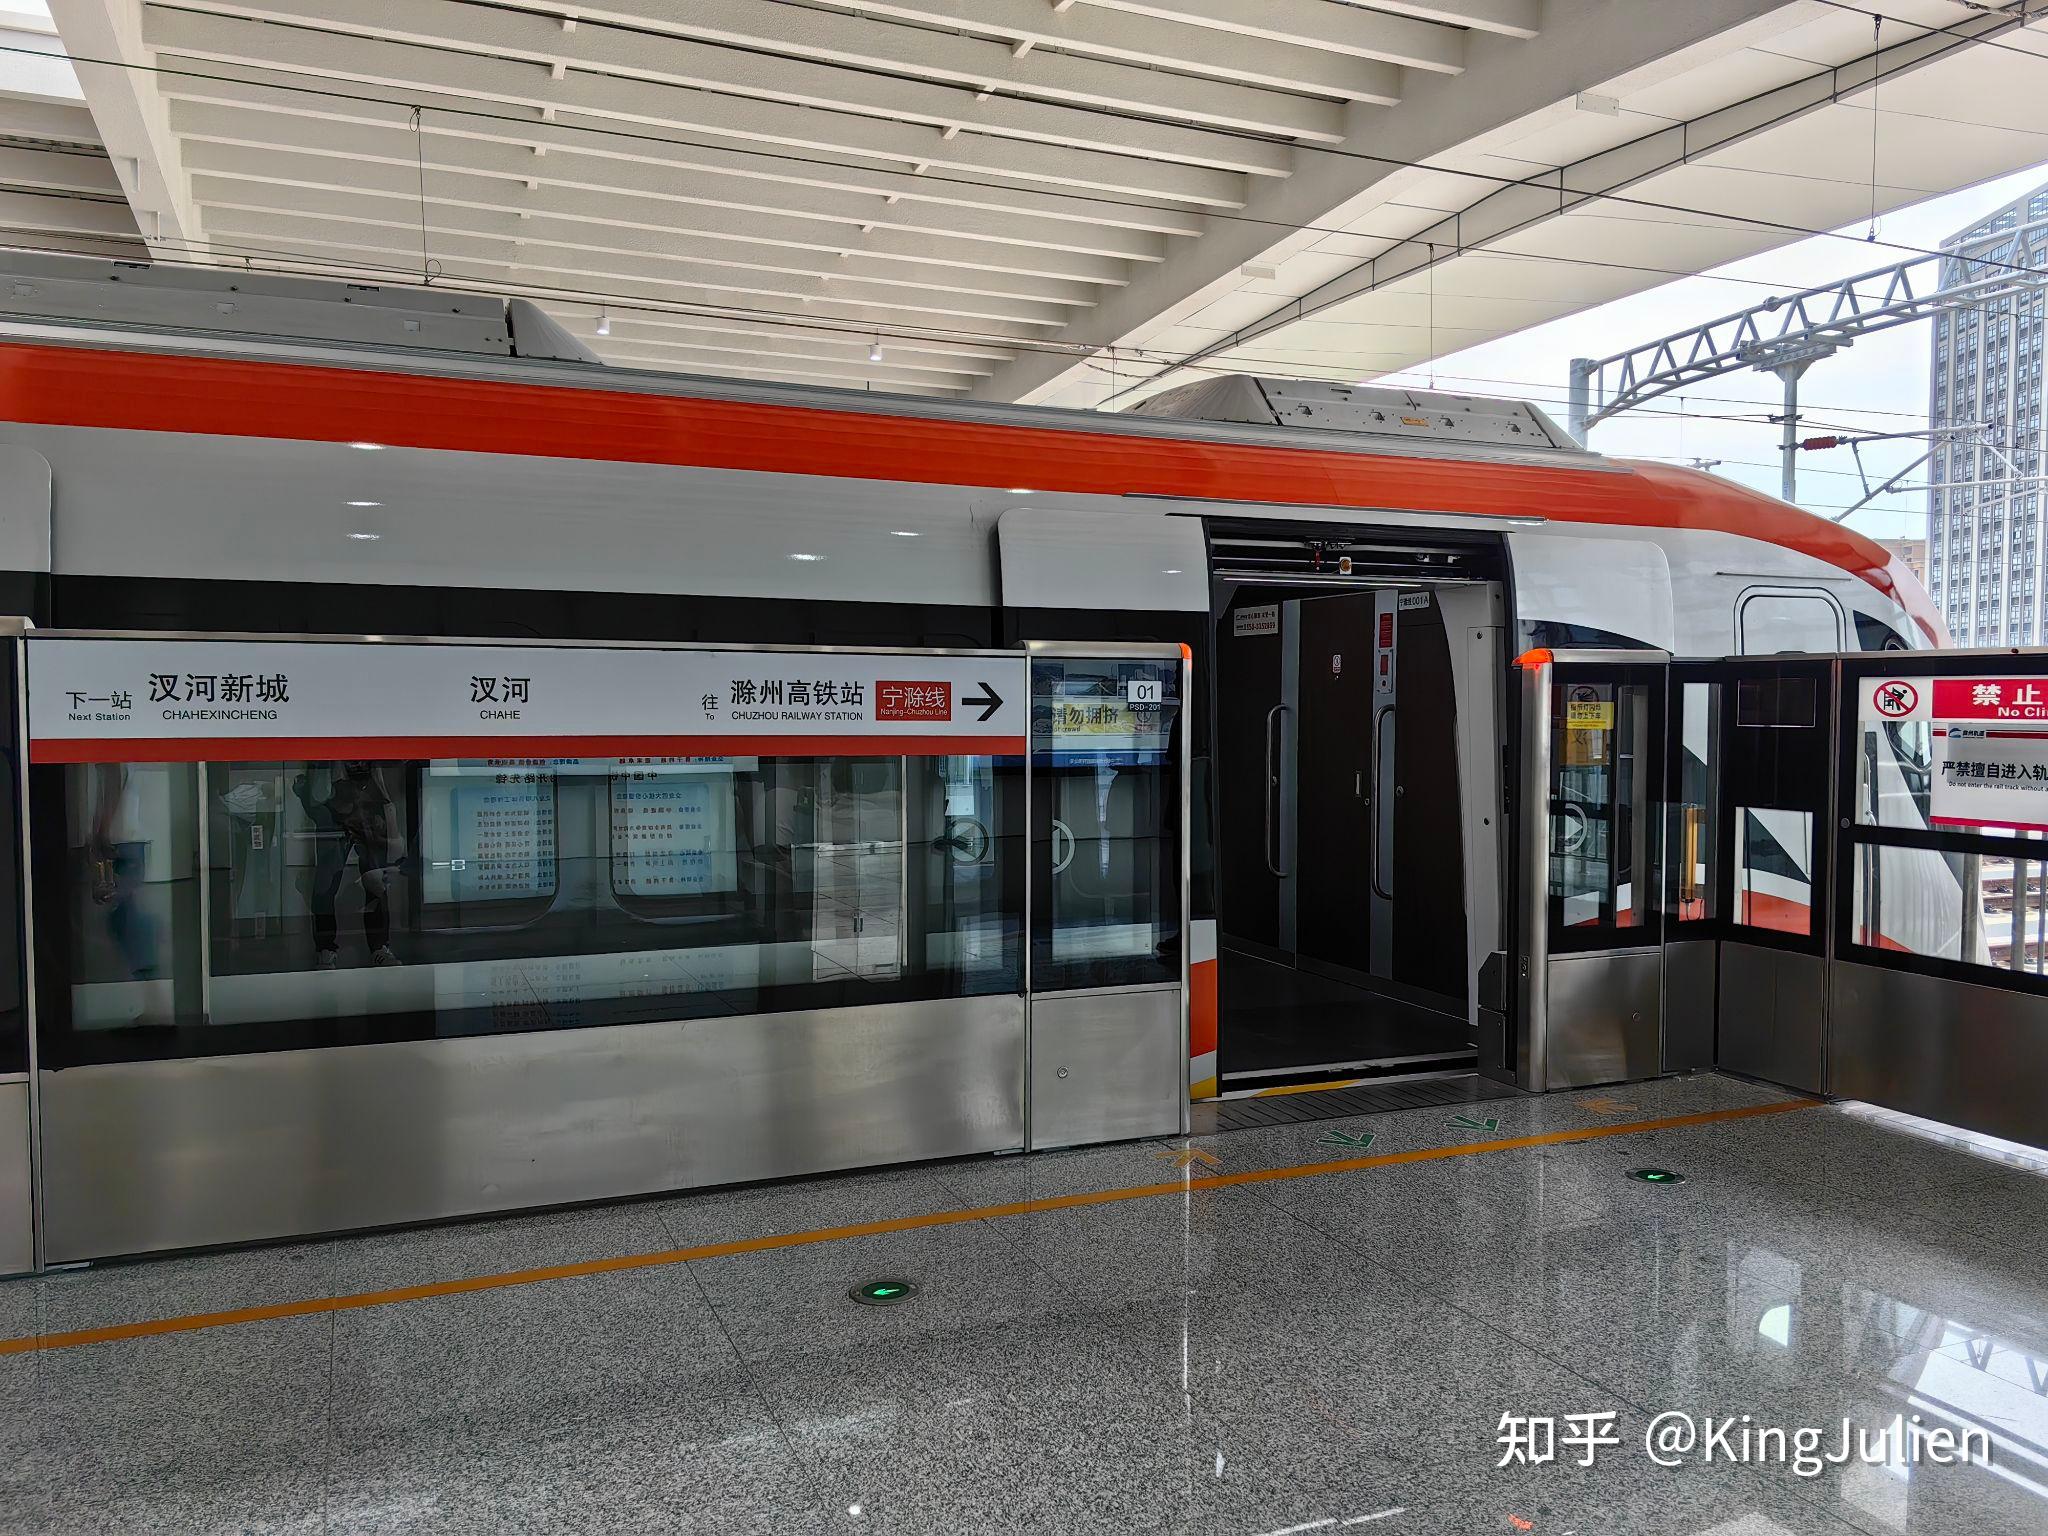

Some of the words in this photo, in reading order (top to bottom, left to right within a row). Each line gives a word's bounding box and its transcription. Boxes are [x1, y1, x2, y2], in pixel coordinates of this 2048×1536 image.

[148, 672, 290, 703] 汊河新城
[469, 675, 531, 703] 汊河
[730, 679, 865, 706] 滁州高铁站
[1136, 684, 1154, 700] 01
[66, 691, 133, 710] 下一站
[882, 685, 945, 708] 宁滁线
[1971, 684, 2044, 706] 禁止
[701, 694, 719, 711] 往
[1129, 703, 1161, 712] PSD-201
[68, 713, 92, 721] Next
[95, 713, 131, 721] Station
[162, 709, 278, 720] CHAHEXINCHENG
[479, 709, 521, 720] CHAHE
[705, 713, 715, 721] To
[731, 711, 779, 721] CHUZHOU
[781, 711, 822, 721] RAILWAY
[824, 711, 863, 721] STATION
[935, 708, 948, 716] Line
[1997, 707, 2020, 717] No
[1983, 782, 1993, 790] the
